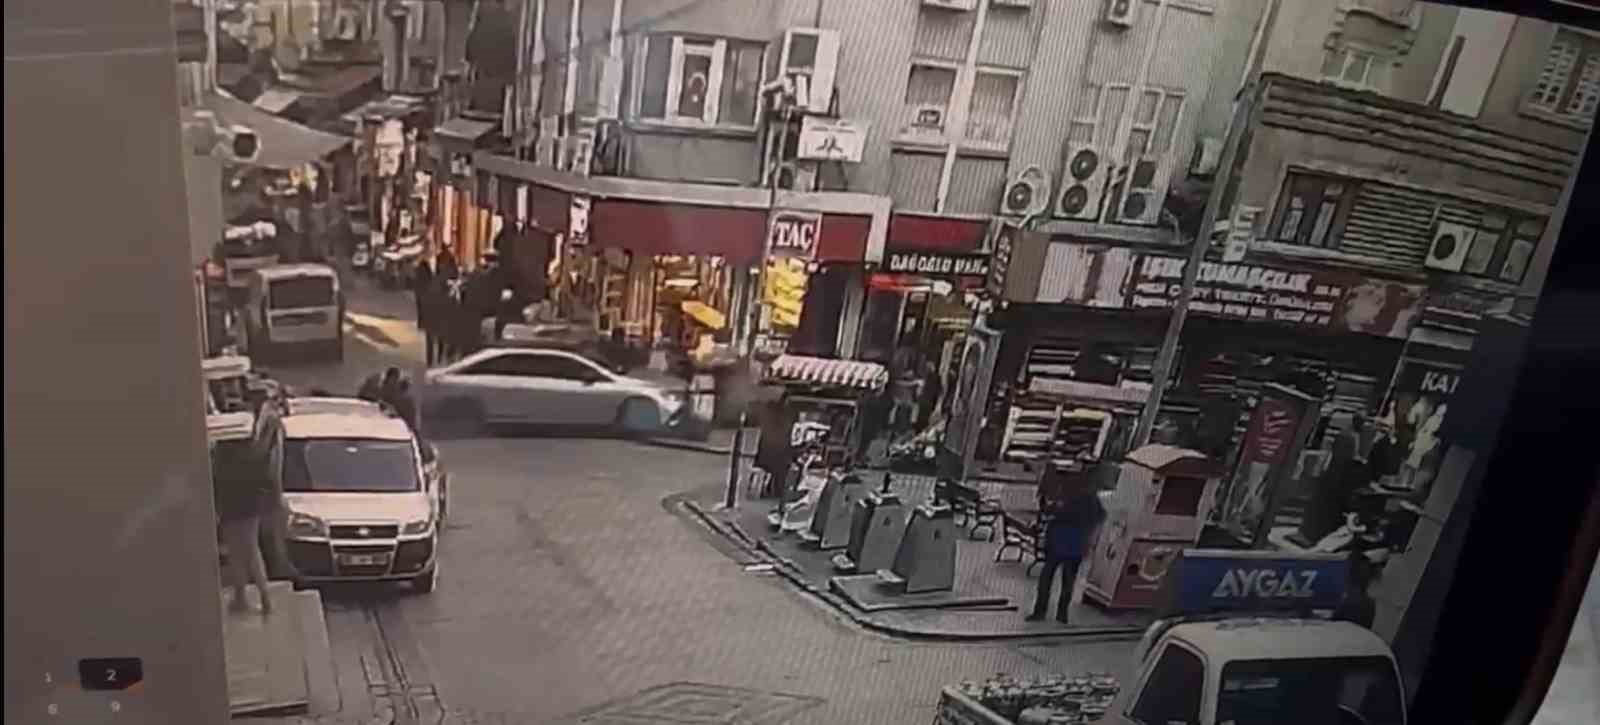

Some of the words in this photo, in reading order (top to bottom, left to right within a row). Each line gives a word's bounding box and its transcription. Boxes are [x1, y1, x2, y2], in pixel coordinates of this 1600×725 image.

[775, 221, 814, 251] TAÇ
[1212, 568, 1318, 598] AYGAZ
[44, 671, 52, 683] 1
[106, 669, 117, 681] 2
